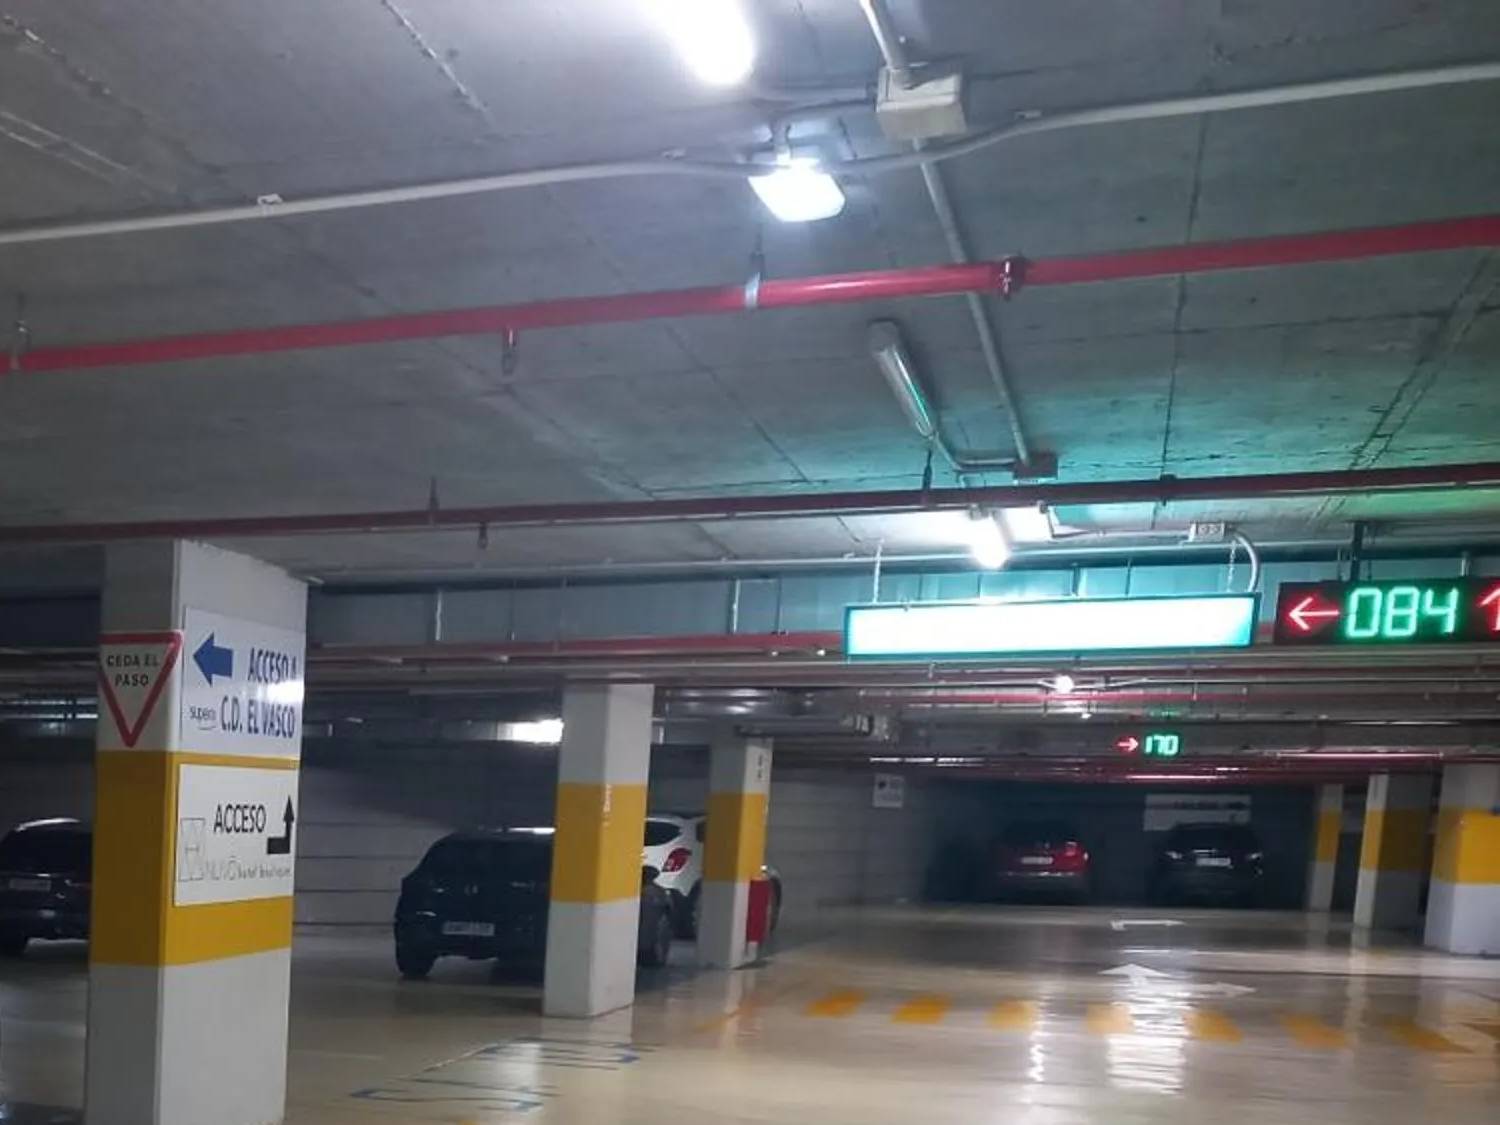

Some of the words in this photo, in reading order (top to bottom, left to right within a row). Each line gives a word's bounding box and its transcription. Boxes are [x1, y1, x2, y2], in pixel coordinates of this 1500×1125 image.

[1346, 586, 1457, 639] 084
[106, 654, 140, 667] CEDA
[144, 652, 160, 667] EL
[247, 647, 289, 684] ACCESO
[115, 673, 149, 687] PASO
[247, 699, 259, 734] EL
[261, 701, 296, 738] VASCO
[1144, 734, 1179, 756] 170
[213, 804, 267, 834] ACCESO
